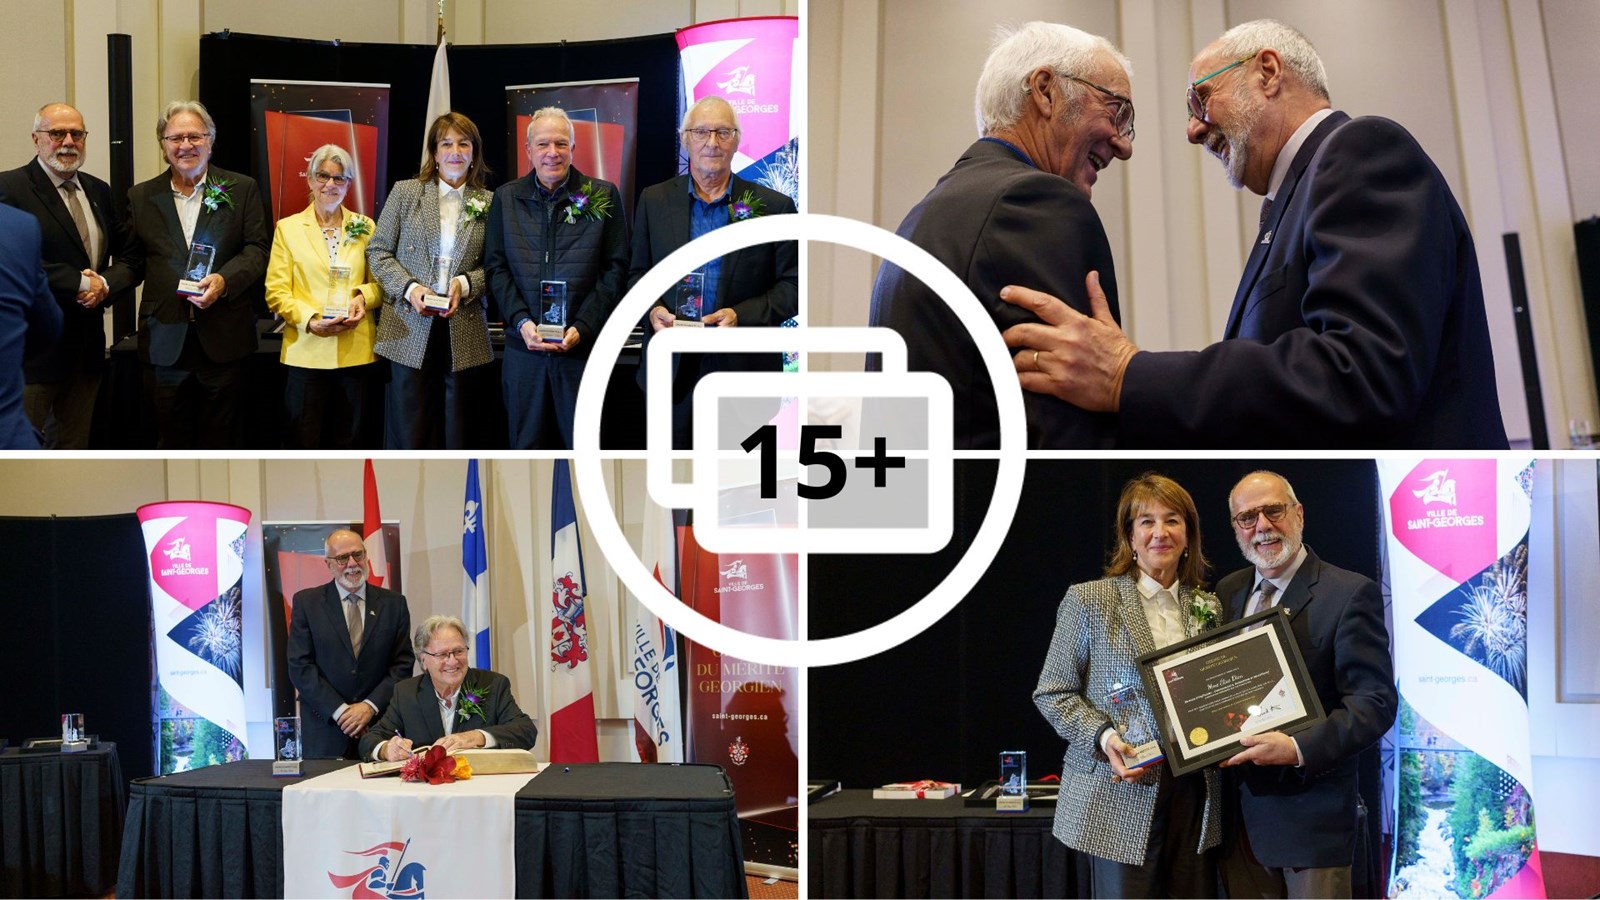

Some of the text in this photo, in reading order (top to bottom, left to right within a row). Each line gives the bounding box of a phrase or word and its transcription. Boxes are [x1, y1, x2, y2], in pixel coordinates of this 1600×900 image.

[735, 104, 779, 114] GEORGES
[1447, 508, 1457, 516] DE
[1407, 515, 1484, 530] SAINT-GEORGES
[161, 568, 209, 576] SAINT-GEORGES
[714, 584, 764, 594] SAINT-GEORGES
[697, 663, 718, 676] DU
[700, 680, 782, 693] GEORGIEN
[712, 712, 768, 721] saint-georges.ca
